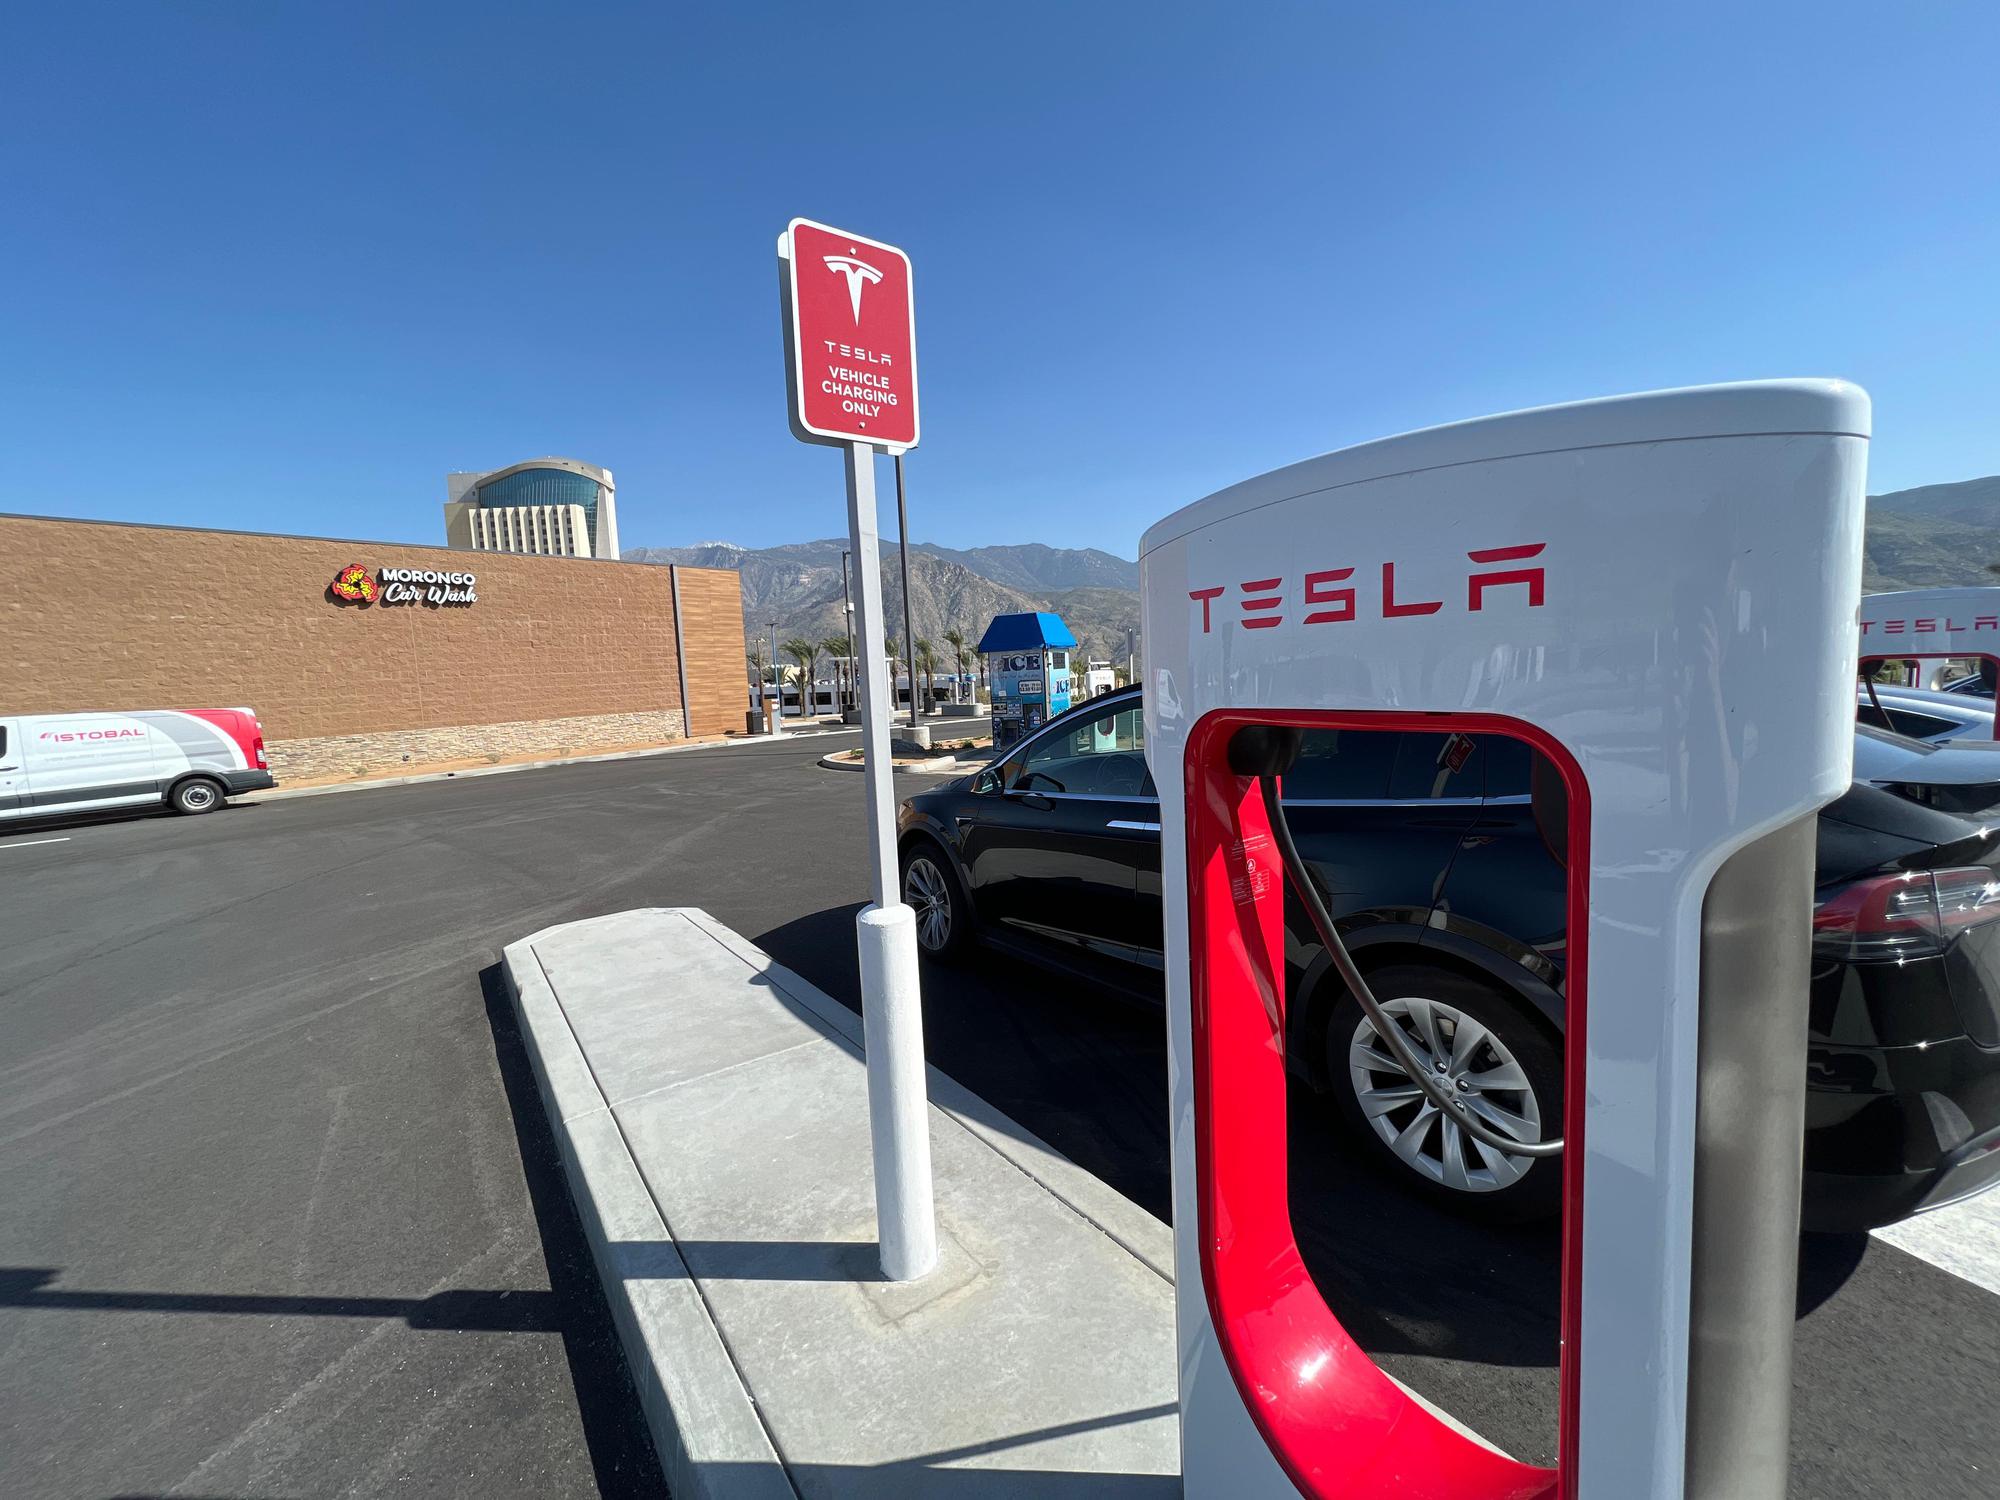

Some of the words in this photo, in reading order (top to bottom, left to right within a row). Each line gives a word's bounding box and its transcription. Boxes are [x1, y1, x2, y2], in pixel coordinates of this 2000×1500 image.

[824, 340, 892, 367] TESLA
[828, 365, 890, 390] VEHICLE
[821, 381, 898, 406] CHARGING
[842, 400, 880, 418] ONLY
[382, 568, 476, 586] MORONGO
[385, 583, 422, 603] Car
[427, 585, 478, 605] Wash
[1188, 542, 1547, 634] TESLA
[1860, 615, 1999, 635] TESLA
[1002, 653, 1040, 672] ICE
[54, 729, 145, 742] ISTOBAL
